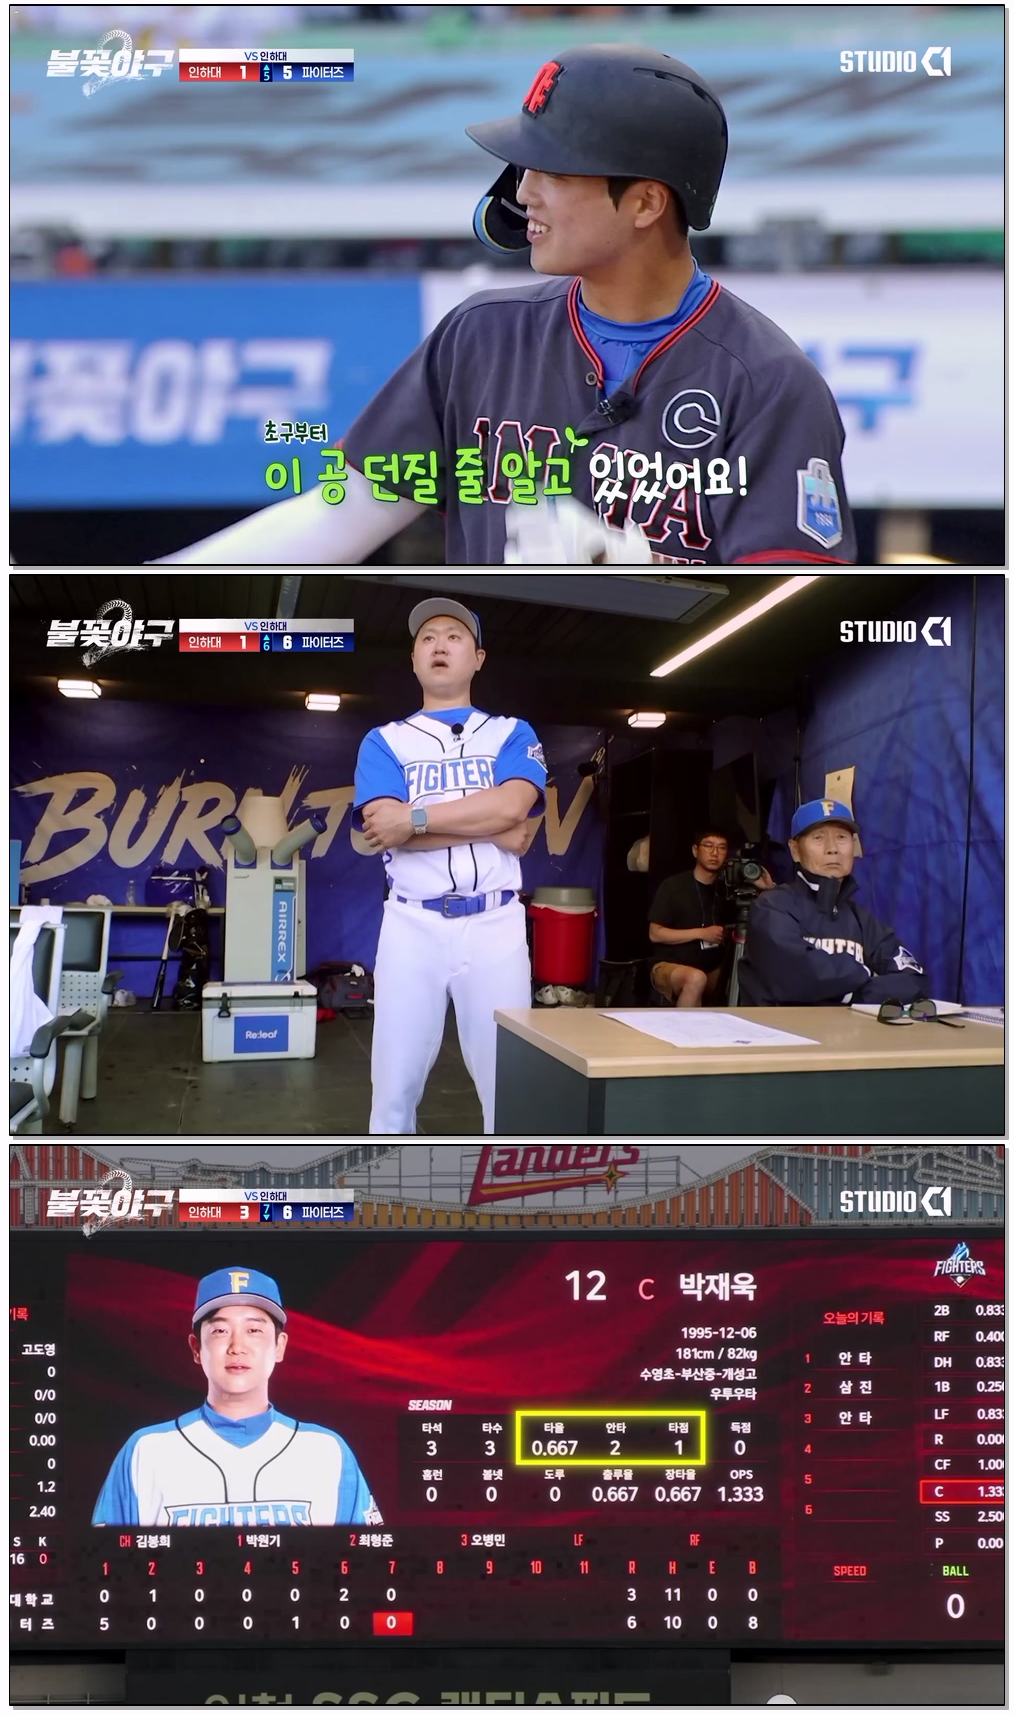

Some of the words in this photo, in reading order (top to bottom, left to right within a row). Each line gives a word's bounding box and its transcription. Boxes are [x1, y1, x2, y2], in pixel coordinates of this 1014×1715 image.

[10, 339, 333, 446] 꽃야구
[662, 389, 720, 449] C
[820, 800, 835, 816] F
[277, 901, 288, 963] AIRREX
[245, 1030, 278, 1039] Re:leaf
[933, 1259, 986, 1278] FIGHTERS
[229, 1271, 250, 1293] F
[566, 1271, 606, 1300] 12
[639, 1279, 654, 1299] C
[681, 1273, 756, 1301] 박재욱
[825, 1312, 858, 1324] 오늘의
[862, 1312, 884, 1323] 기록
[682, 1327, 756, 1338] 1995-12-06
[22, 1344, 55, 1356] 고도영
[676, 1348, 714, 1359] 181cm
[728, 1348, 757, 1361] 82kg
[640, 1368, 757, 1381] 수영초-부산중-개성고
[711, 1388, 757, 1400] 우투우타
[409, 1400, 451, 1410] SEASON
[423, 1423, 441, 1433] 타석
[483, 1423, 502, 1433] 타수
[545, 1423, 564, 1433] 타율
[606, 1423, 626, 1433] 안타
[669, 1423, 688, 1433] 타점
[731, 1423, 750, 1433] 득점
[427, 1441, 437, 1455] 3
[485, 1441, 495, 1455] 3
[532, 1441, 577, 1456] 0.667
[610, 1441, 620, 1455] 2
[675, 1440, 682, 1455] 1
[735, 1440, 745, 1455] 0
[423, 1470, 442, 1480] 홈런
[483, 1470, 502, 1480] 볼넷
[545, 1469, 564, 1480] 도루
[603, 1469, 632, 1480] 출루율
[666, 1469, 695, 1480] 장타율
[730, 1470, 753, 1479] OPS
[427, 1487, 437, 1502] 0
[486, 1487, 497, 1501] 0
[550, 1487, 560, 1501] 0
[593, 1487, 638, 1502] 0.667
[655, 1487, 701, 1502] 0.667
[718, 1487, 763, 1502] 1.333
[137, 1535, 169, 1548] 김봉희
[238, 1535, 241, 1546] 1
[247, 1535, 280, 1547] 박원기
[350, 1535, 355, 1546] 2
[359, 1535, 393, 1547] 최형준
[462, 1534, 467, 1545] 3
[471, 1534, 504, 1546] 오병민
[835, 1566, 865, 1575] SPEED
[943, 1566, 968, 1575] BALL
[947, 1594, 964, 1618] 0
